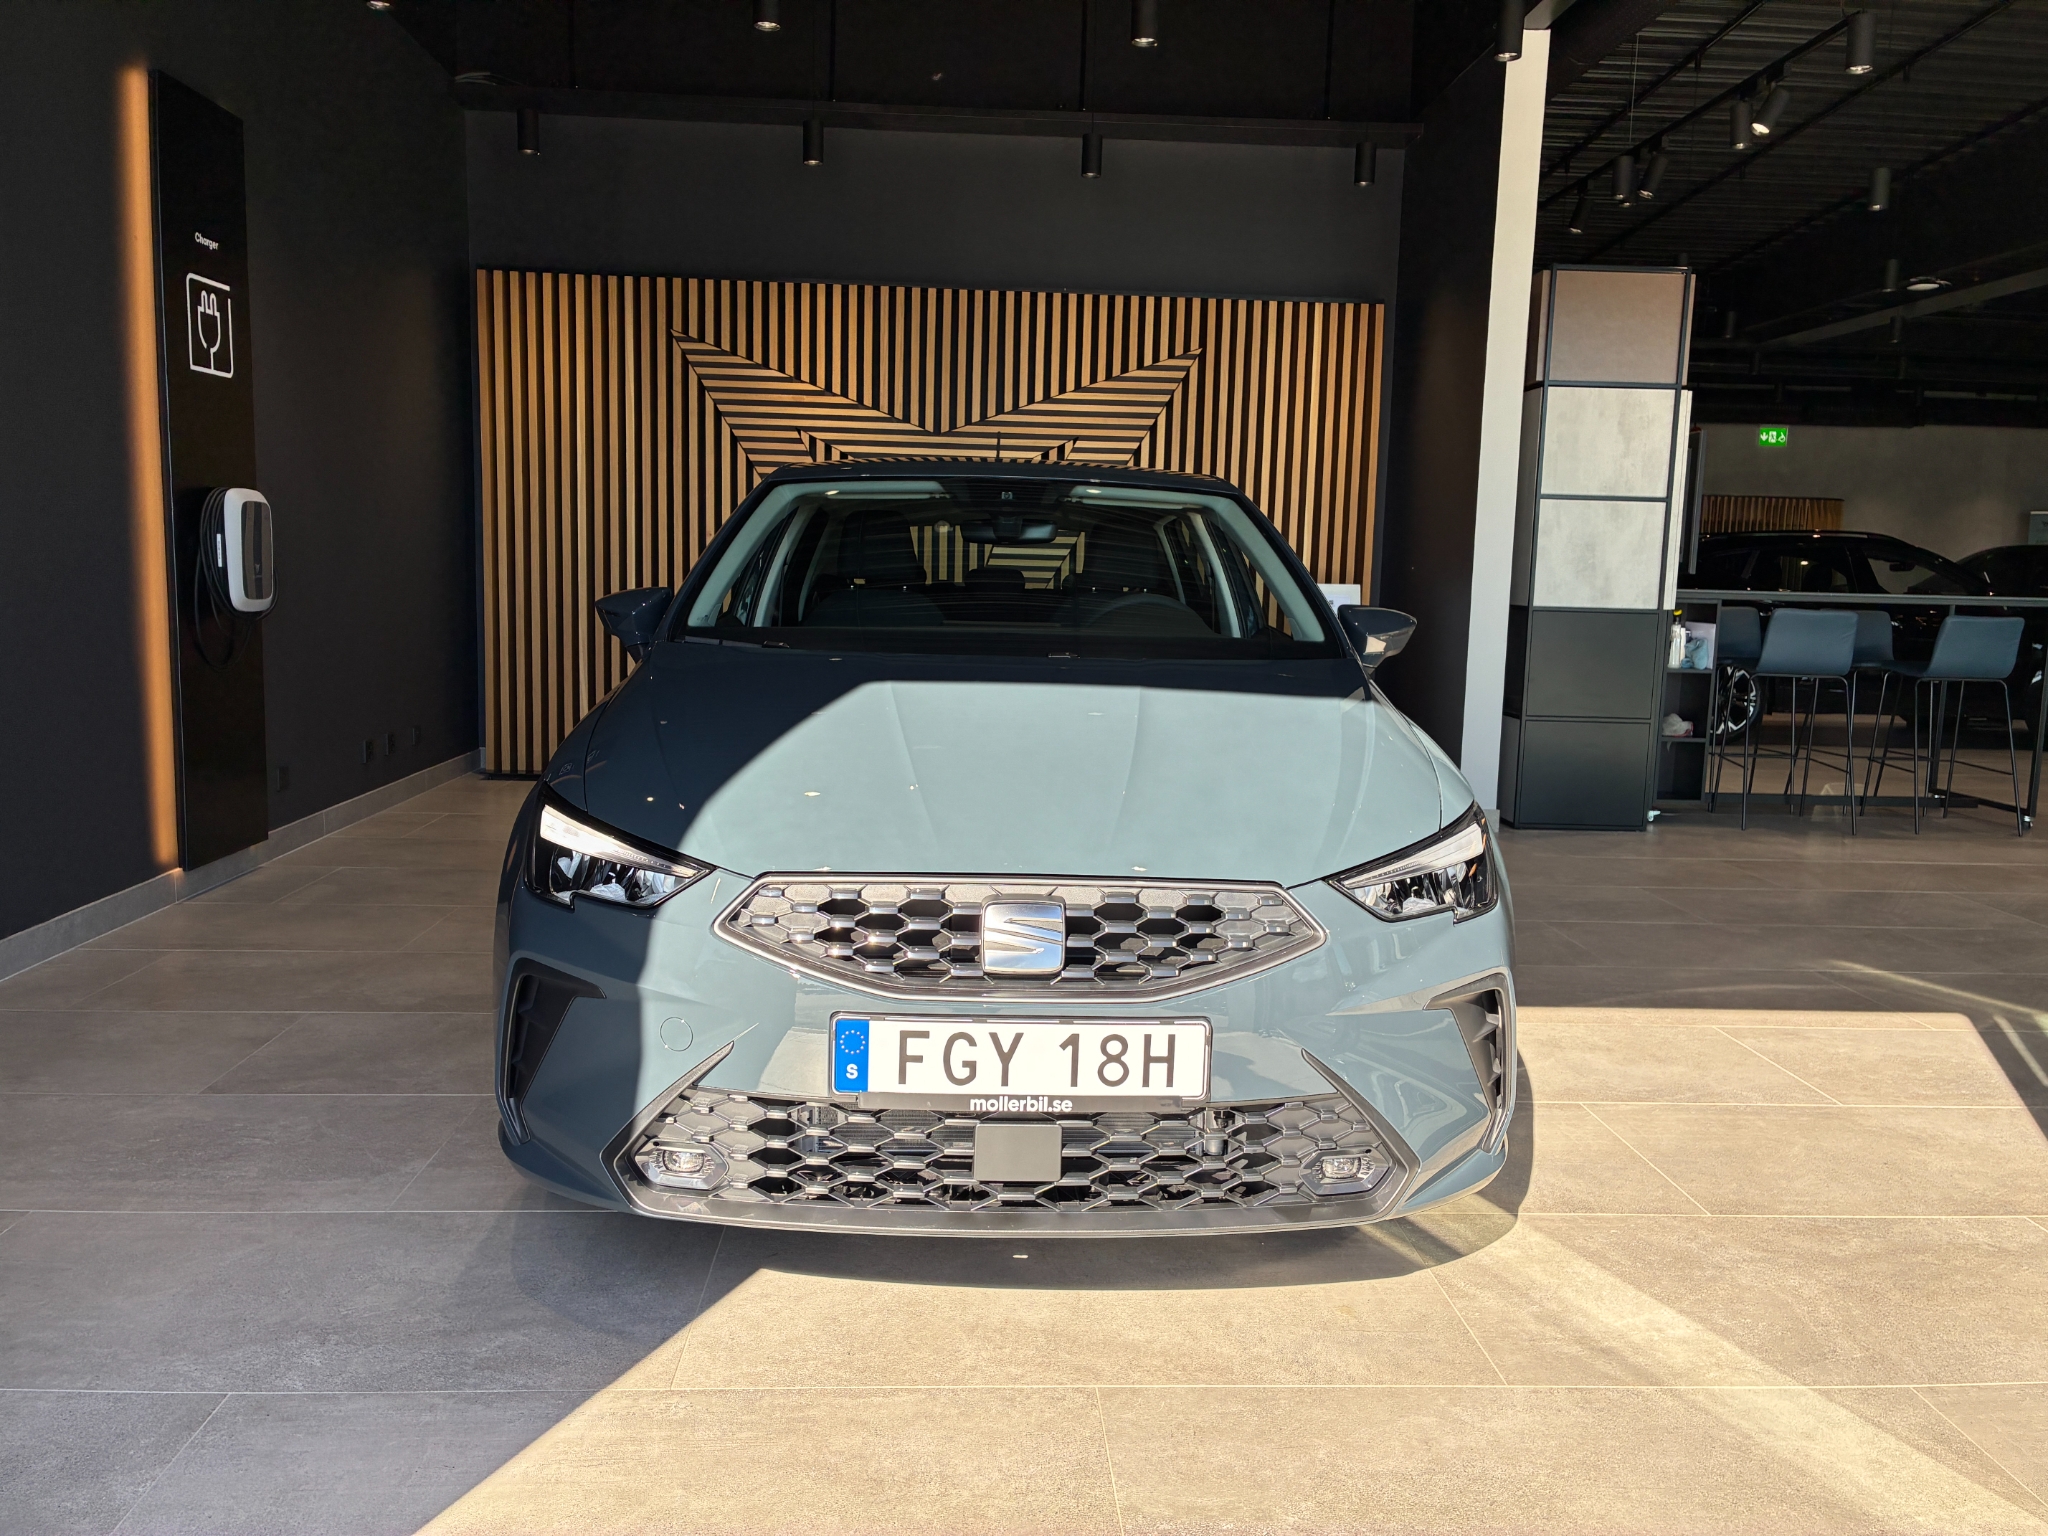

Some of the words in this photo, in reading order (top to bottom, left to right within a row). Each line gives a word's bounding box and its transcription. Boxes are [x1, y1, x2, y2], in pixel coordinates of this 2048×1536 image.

[194, 231, 219, 250] Charger
[897, 1030, 1025, 1087] FGY
[1058, 1032, 1176, 1088] 18H
[845, 1063, 859, 1080] S
[969, 1096, 1073, 1113] mollerbil.se
